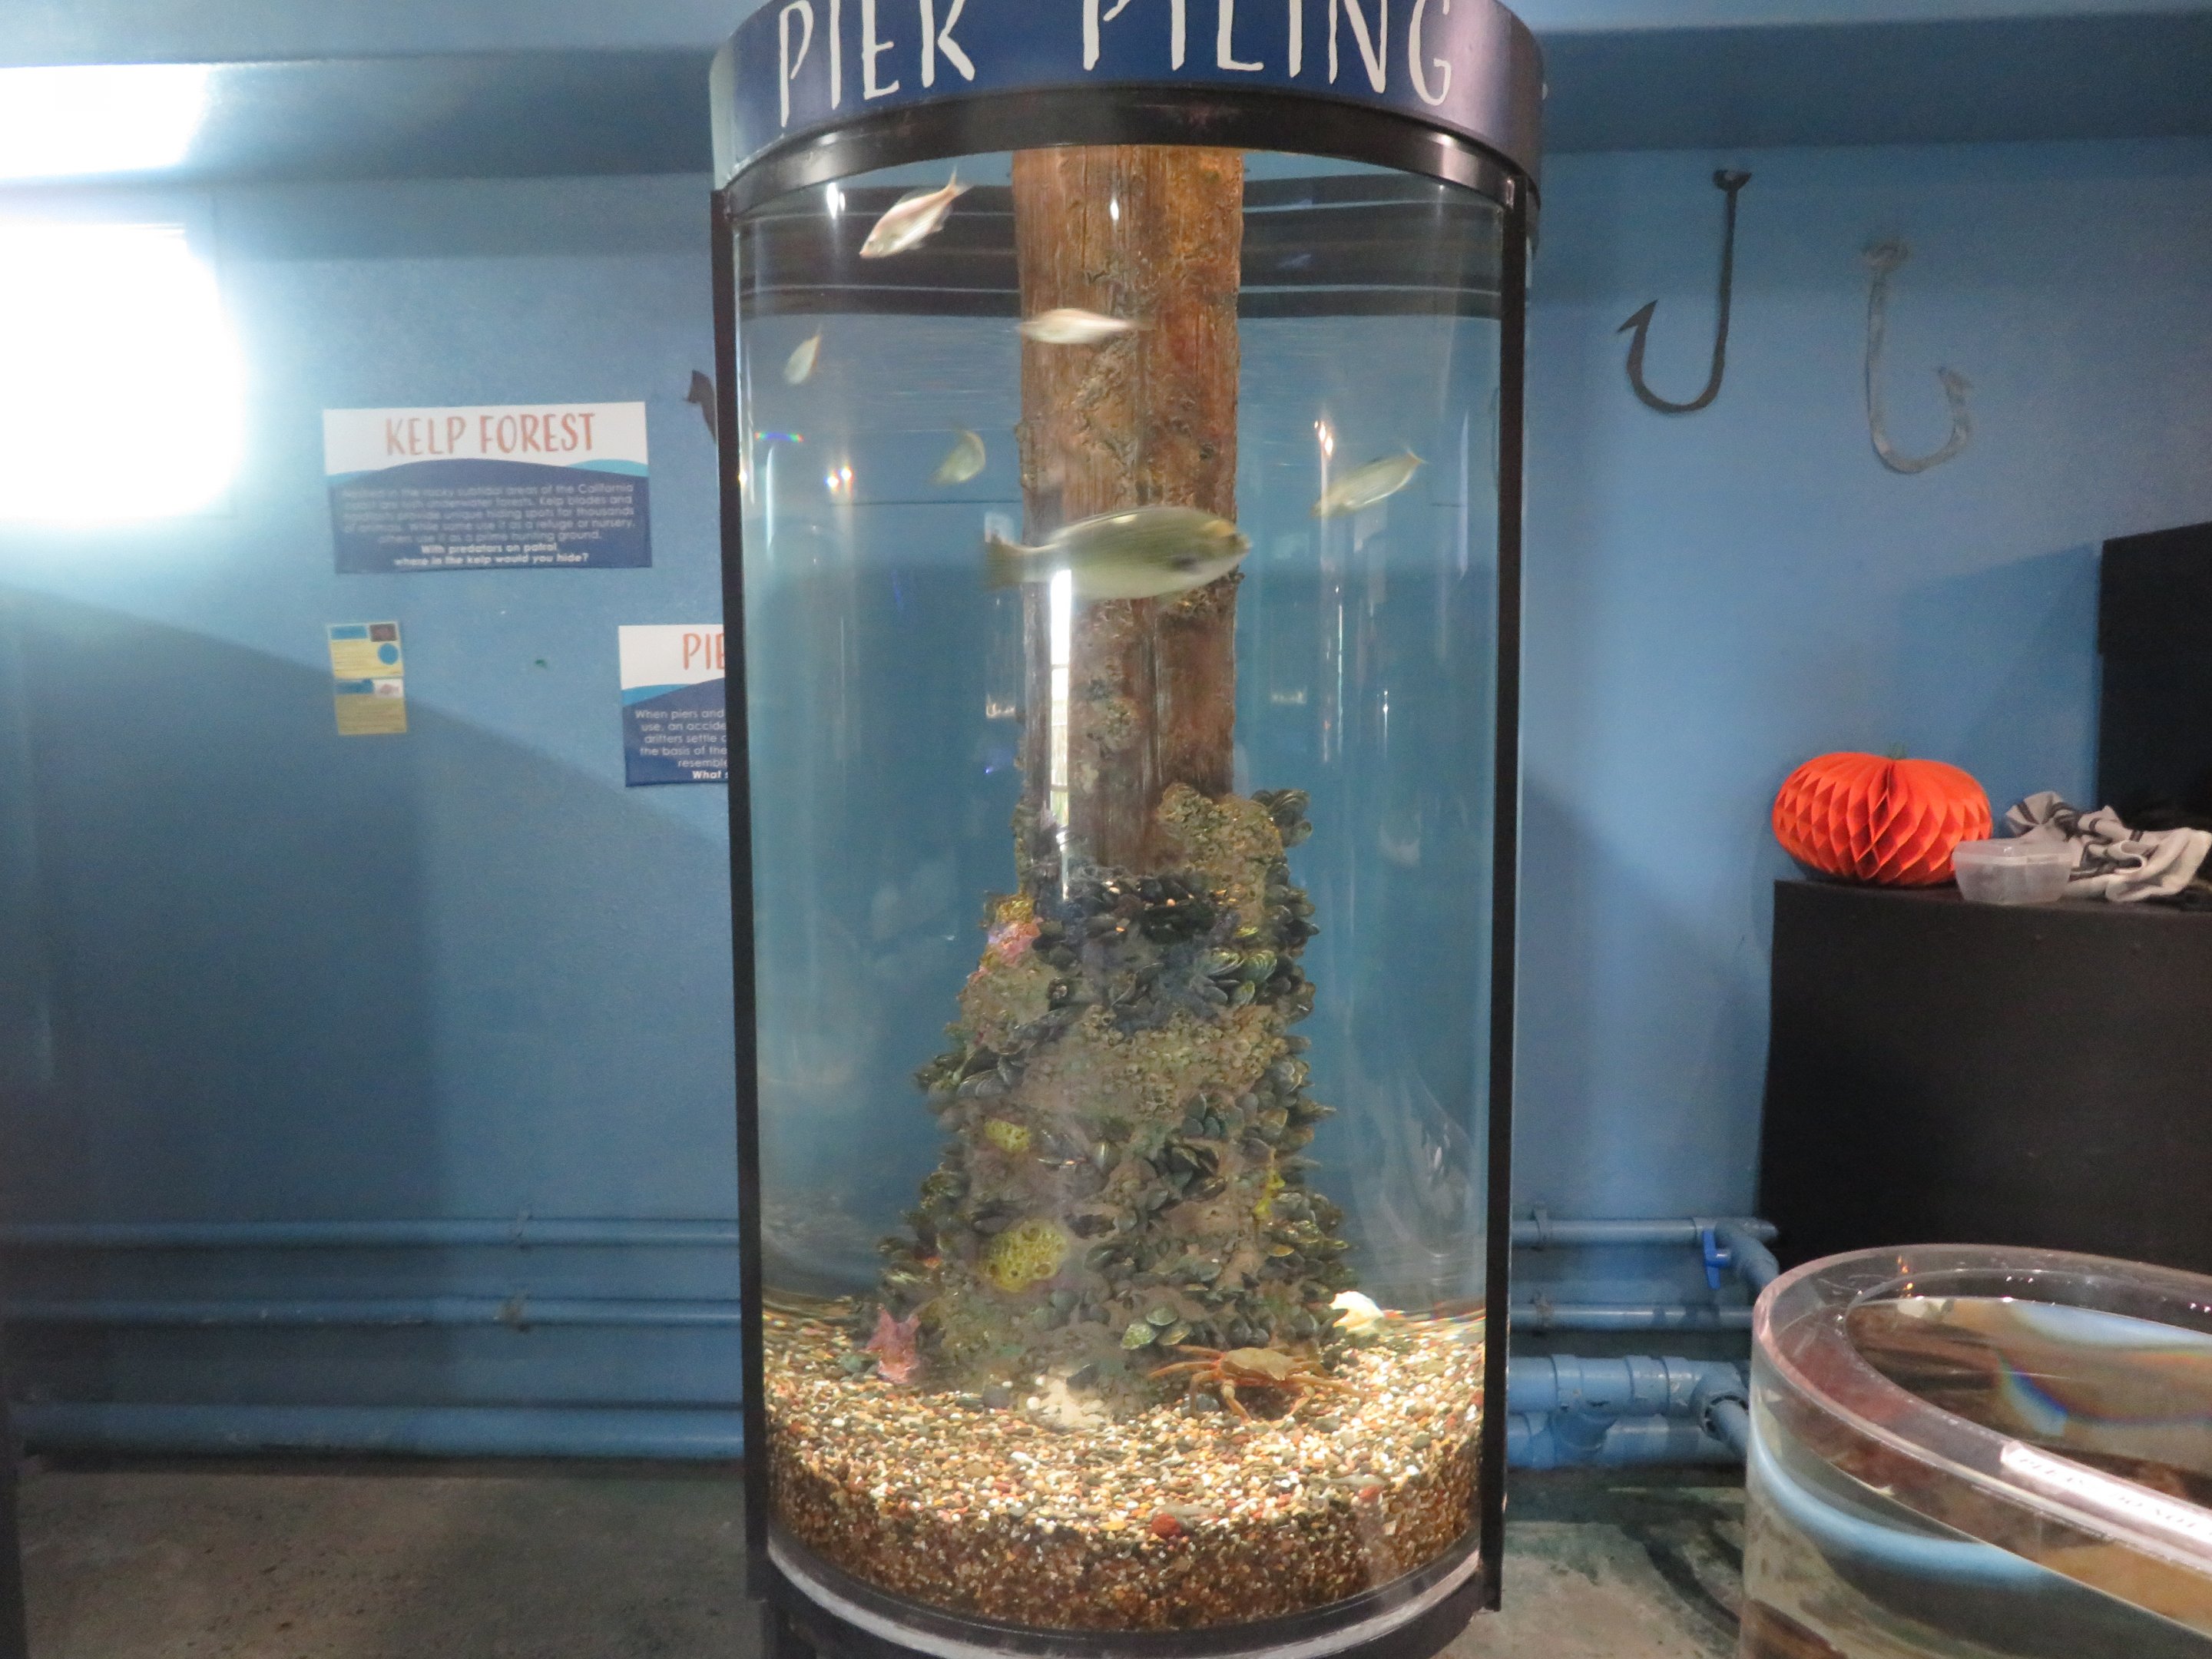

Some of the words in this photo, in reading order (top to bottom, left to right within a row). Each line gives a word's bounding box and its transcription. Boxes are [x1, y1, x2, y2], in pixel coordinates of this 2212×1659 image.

[386, 416, 466, 455] KELP
[480, 412, 595, 454] FOREST
[541, 484, 553, 494] of
[556, 484, 575, 494] the
[578, 482, 634, 494] California
[540, 496, 565, 508] Kelp
[568, 495, 606, 505] blades
[610, 495, 633, 505] and
[558, 507, 573, 517] for
[577, 507, 634, 518] thousands
[536, 519, 575, 531] refuge
[577, 520, 589, 529] or
[558, 530, 602, 542] ground.
[448, 543, 503, 555] predators
[505, 544, 521, 552] on
[445, 555, 464, 565] the
[466, 554, 492, 566] kelp
[495, 553, 529, 563] would
[532, 555, 555, 565] you
[556, 551, 590, 562] hide?
[683, 633, 725, 671] PIE
[634, 708, 668, 719] When
[671, 709, 699, 720] piers
[701, 708, 725, 718] and
[667, 723, 684, 731] an
[644, 733, 684, 744] drifters
[687, 733, 718, 743] settle
[639, 747, 661, 757] the
[662, 746, 691, 757] basis
[694, 745, 707, 755] of
[709, 745, 727, 755] the
[692, 770, 723, 780] What
